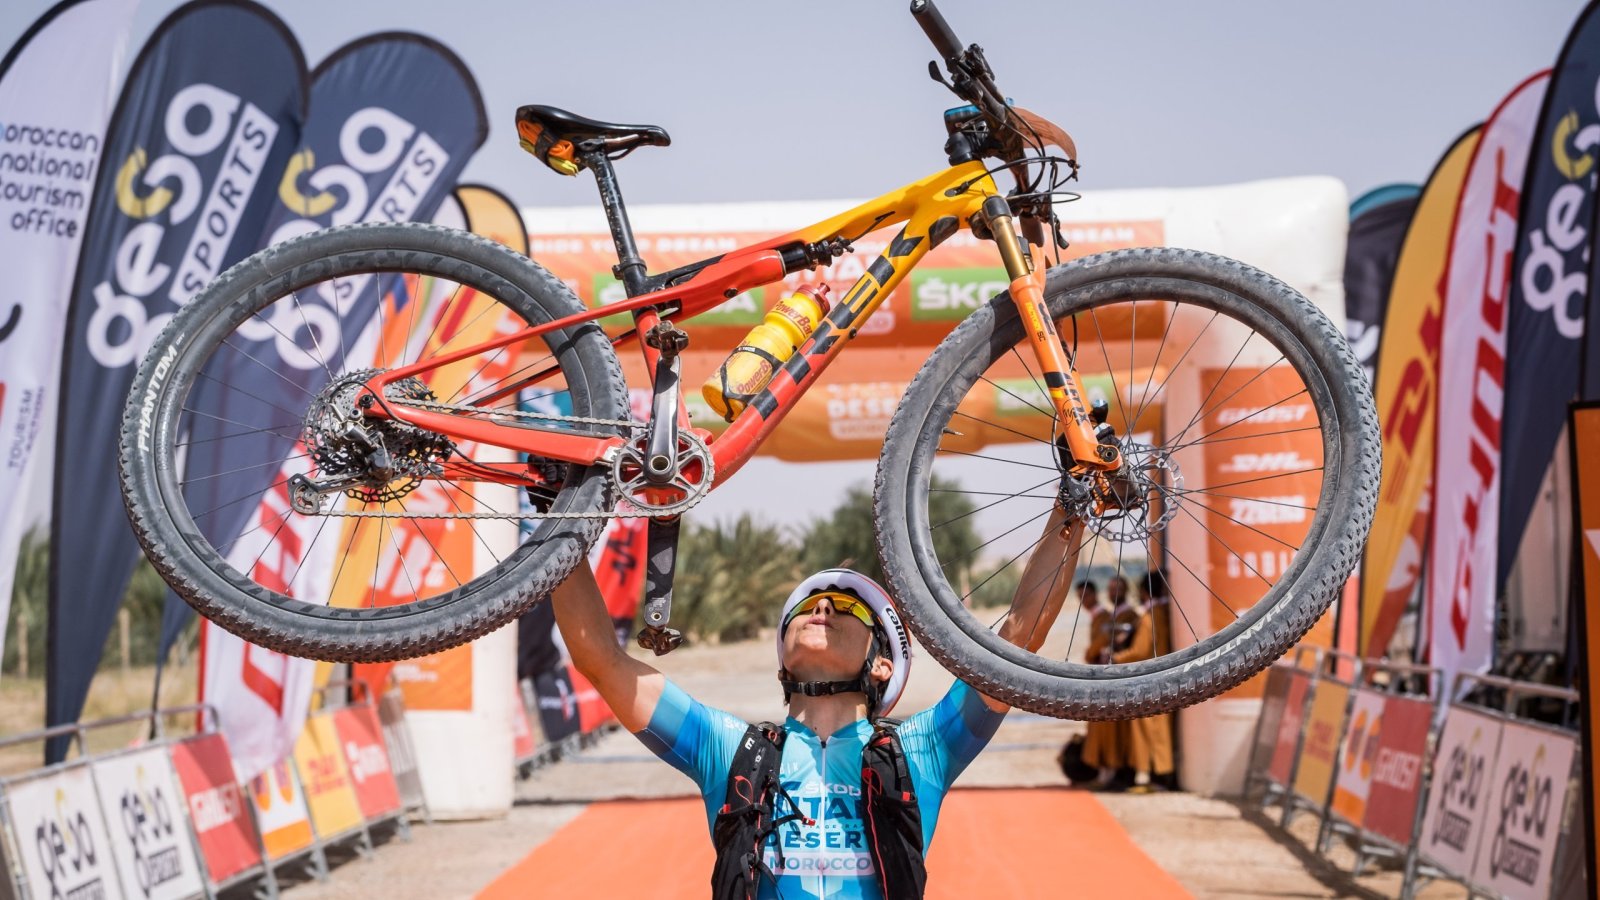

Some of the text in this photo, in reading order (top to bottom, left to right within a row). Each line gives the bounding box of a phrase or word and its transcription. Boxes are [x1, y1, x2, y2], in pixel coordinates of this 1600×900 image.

[0, 151, 94, 182] national
[11, 208, 77, 238] office
[656, 236, 737, 252] DREAM
[138, 345, 178, 452] PHANTOM
[1217, 404, 1309, 424] GHOST
[885, 606, 909, 661] catlike
[1183, 591, 1293, 673] PHANTOM
[769, 856, 871, 871] MOROCCO
